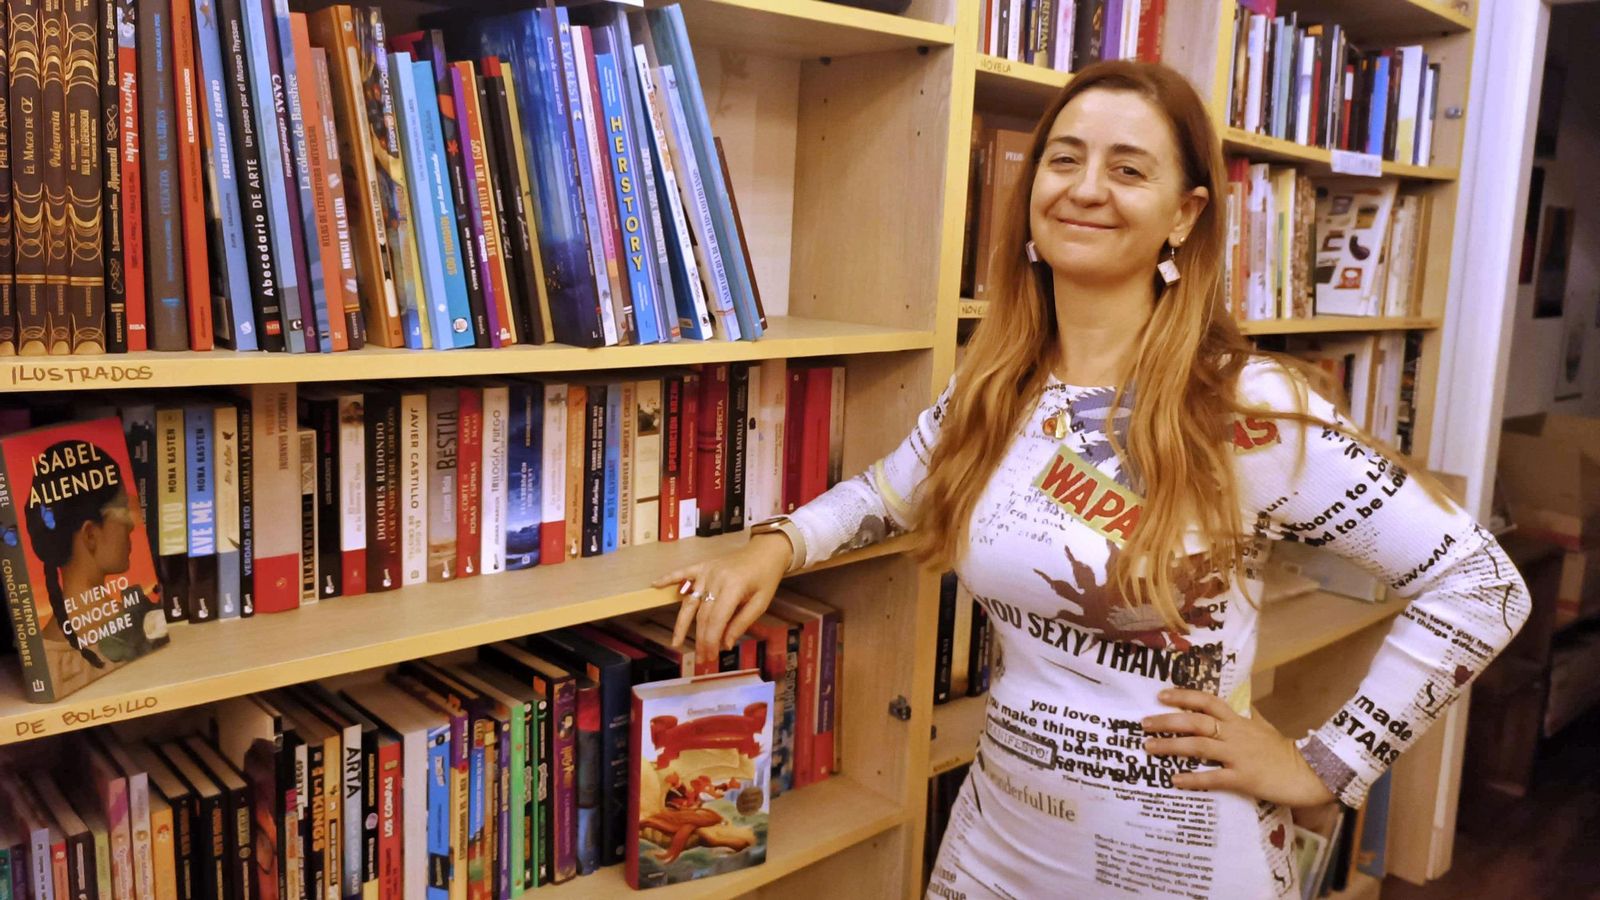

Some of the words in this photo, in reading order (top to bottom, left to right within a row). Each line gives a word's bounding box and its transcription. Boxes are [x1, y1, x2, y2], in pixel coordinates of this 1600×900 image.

[231, 20, 242, 53] Thyssen
[1039, 0, 1050, 55] RISHAM
[235, 55, 245, 83] Museo
[560, 41, 580, 103] EVEREST
[980, 59, 1012, 73] NOVELA
[21, 96, 34, 114] OZ
[121, 72, 136, 113] Mujeres
[212, 80, 222, 118] GRANDES
[238, 84, 246, 92] el
[240, 94, 249, 108] por
[272, 74, 286, 114] CASAS
[288, 74, 302, 120] Banshee
[25, 117, 34, 129] DE
[242, 109, 253, 134] paseo
[293, 124, 304, 138] de
[22, 134, 34, 162] MAGO
[126, 131, 139, 162] lucha
[215, 122, 231, 179] AVENTUREROS
[246, 136, 253, 148] Un
[296, 140, 310, 174] cólera
[470, 140, 482, 160] SOY
[24, 164, 34, 174] EL
[247, 159, 260, 189] ARTE
[300, 176, 310, 190] La
[474, 164, 484, 183] UNA
[252, 193, 263, 208] DE
[334, 198, 346, 218] SELVA
[477, 188, 491, 216] CHICA
[610, 116, 645, 272] HERSTORY
[254, 214, 274, 296] Abecedario
[962, 306, 983, 314] NOVE
[12, 365, 154, 385] ILUSTRADOS
[410, 408, 420, 448] JAVIER
[492, 410, 503, 442] FUEGO
[716, 400, 724, 442] PERFECTA
[736, 417, 744, 450] BATALLA
[166, 428, 176, 464] KASTEN
[196, 428, 206, 464] KASTEN
[376, 422, 386, 482] REDONDO
[436, 410, 457, 470] BESTIA
[32, 442, 102, 478] ISABEL
[490, 446, 501, 492] TRILOGÍA
[734, 452, 742, 483] ÚLTIMA
[28, 464, 119, 510] ALLENDE
[168, 468, 177, 493] MONA
[196, 466, 206, 492] MONA
[242, 463, 250, 502] CAMILLA
[410, 452, 420, 510] CASTILLO
[714, 478, 722, 490] LA
[734, 484, 742, 494] LA
[162, 502, 184, 532] YOU
[192, 500, 213, 525] ME
[376, 485, 387, 540] DOLORES
[1303, 500, 1346, 532] born
[1346, 482, 1368, 501] to
[1336, 519, 1358, 534] to
[1356, 498, 1384, 519] be
[244, 538, 252, 576] VERDAD
[2, 558, 20, 604] CONOCE
[18, 583, 28, 598] EL
[64, 598, 78, 615] EL
[80, 576, 130, 606] VIENTO
[12, 606, 22, 622] MI
[22, 598, 38, 637] VIENTO
[62, 602, 118, 636] CONOCE
[122, 591, 140, 610] MI
[16, 622, 33, 668] NOMBRE
[77, 614, 134, 650] NOMBRE
[1028, 612, 1088, 658] SEXY
[16, 720, 46, 736] DE
[62, 696, 158, 726] BOLSILLO
[1002, 706, 1038, 728] make
[1042, 721, 1099, 743] things
[1030, 698, 1058, 715] you
[1064, 706, 1106, 728] love,
[1354, 695, 1414, 742] made
[1332, 710, 1401, 765] STARS
[346, 746, 362, 800] ARTA
[384, 776, 394, 816] COMPAS
[1046, 796, 1076, 822] life
[384, 818, 394, 838] LOS
